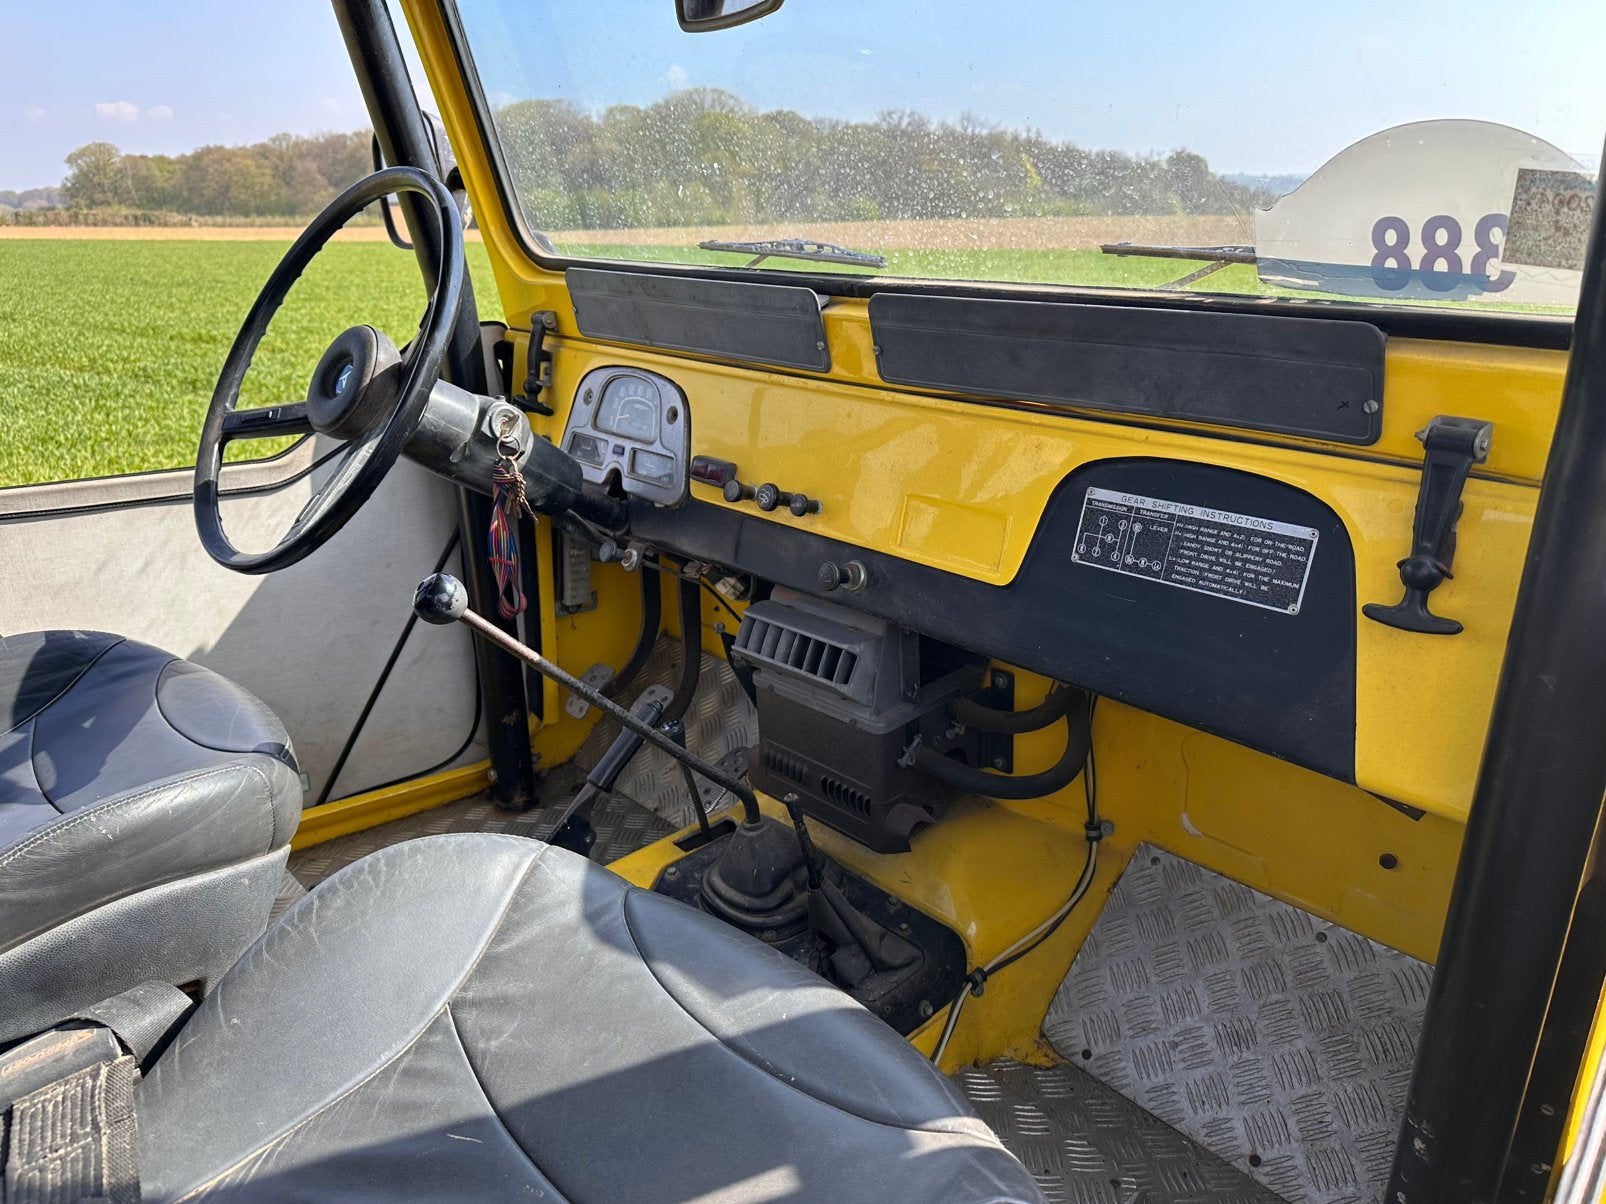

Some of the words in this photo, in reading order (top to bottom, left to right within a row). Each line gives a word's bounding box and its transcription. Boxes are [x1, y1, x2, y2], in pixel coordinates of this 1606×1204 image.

[1091, 500, 1127, 511] TRANSMISSION
[1120, 495, 1145, 506] GEAR
[1151, 500, 1194, 515] SHIFTING
[1199, 510, 1273, 530] INSTRUCTIONS
[1139, 509, 1168, 519] TRANSFER
[1149, 524, 1168, 532] LEVER
[1199, 526, 1218, 534] RANGE
[1198, 535, 1216, 543] RANGE
[1171, 573, 1196, 583] ENGAGED
[1271, 578, 1299, 589] MAXIMUM
